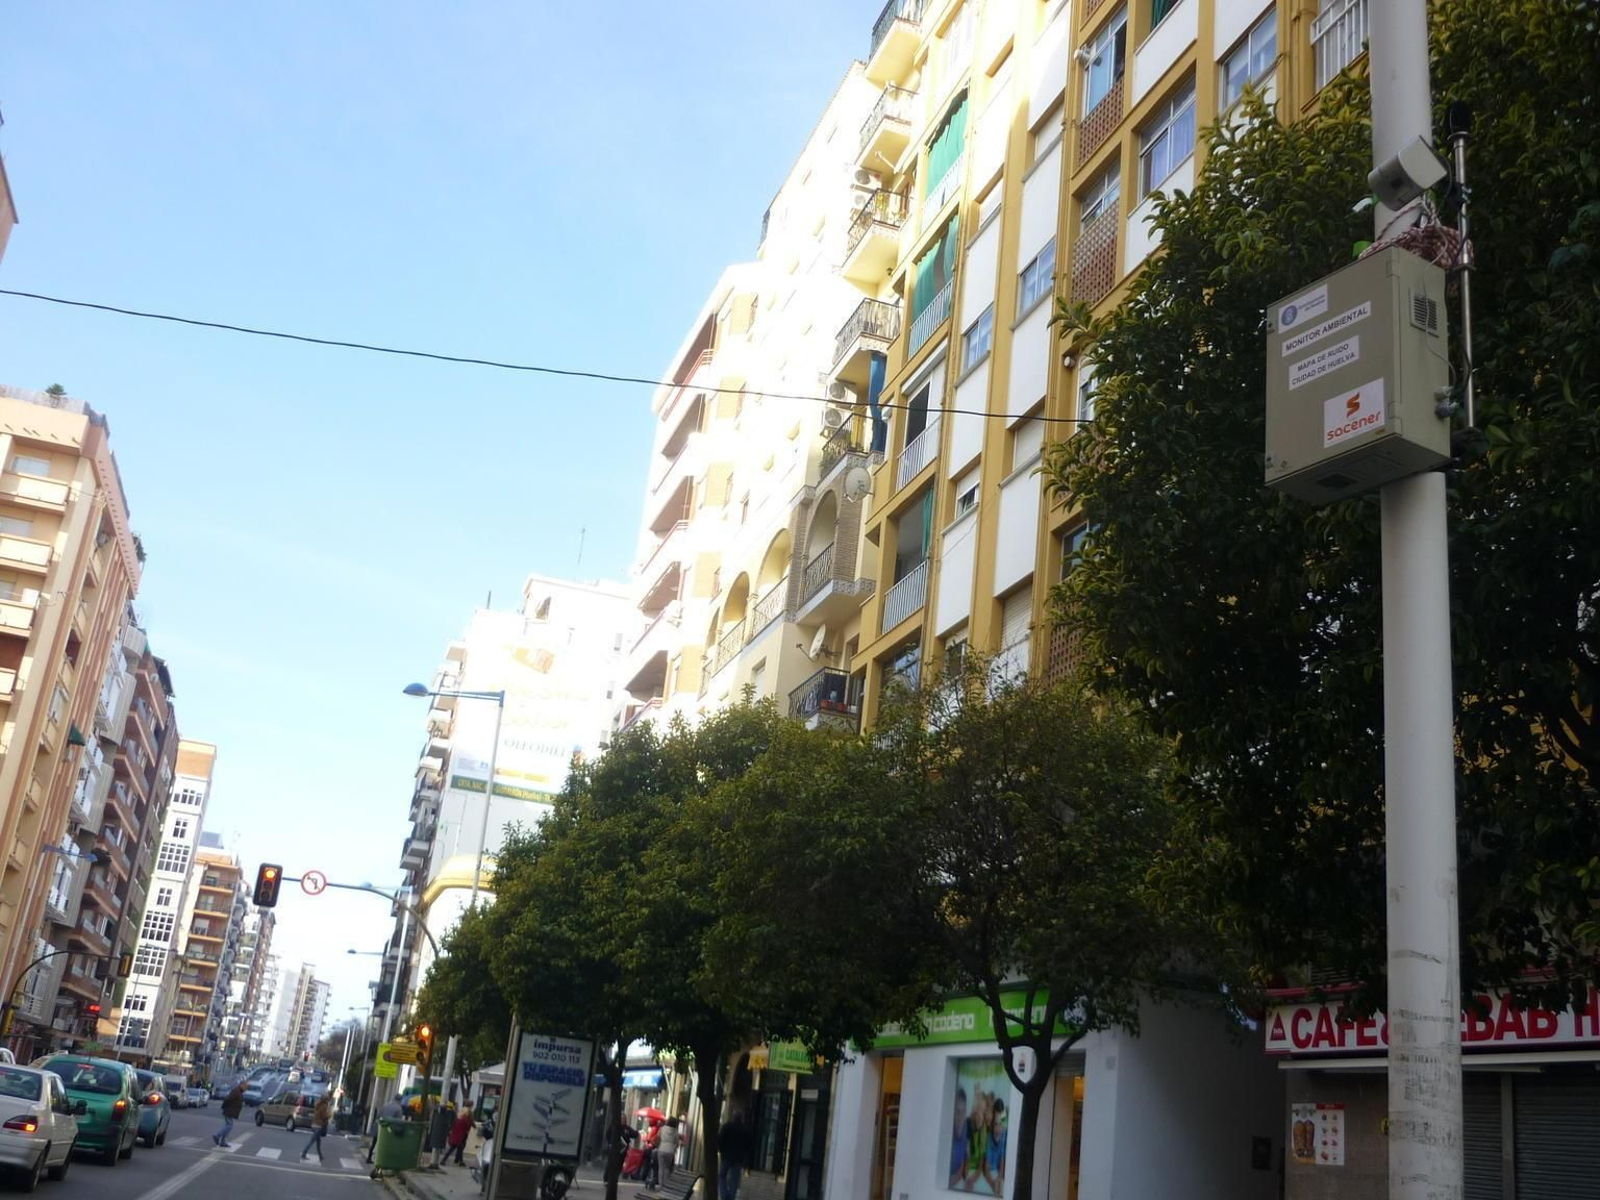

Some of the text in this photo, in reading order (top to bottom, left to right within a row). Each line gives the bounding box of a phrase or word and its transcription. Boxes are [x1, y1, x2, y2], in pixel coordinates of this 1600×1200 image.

[1285, 307, 1368, 351] MONITOR AMBIENTAL
[1291, 351, 1355, 386] CIUDAD DE HUELVA
[1297, 343, 1349, 372] MAPA DE RUIDO
[1327, 411, 1381, 441] socener
[1461, 993, 1558, 1041] BAB
[533, 1038, 582, 1054] impursa
